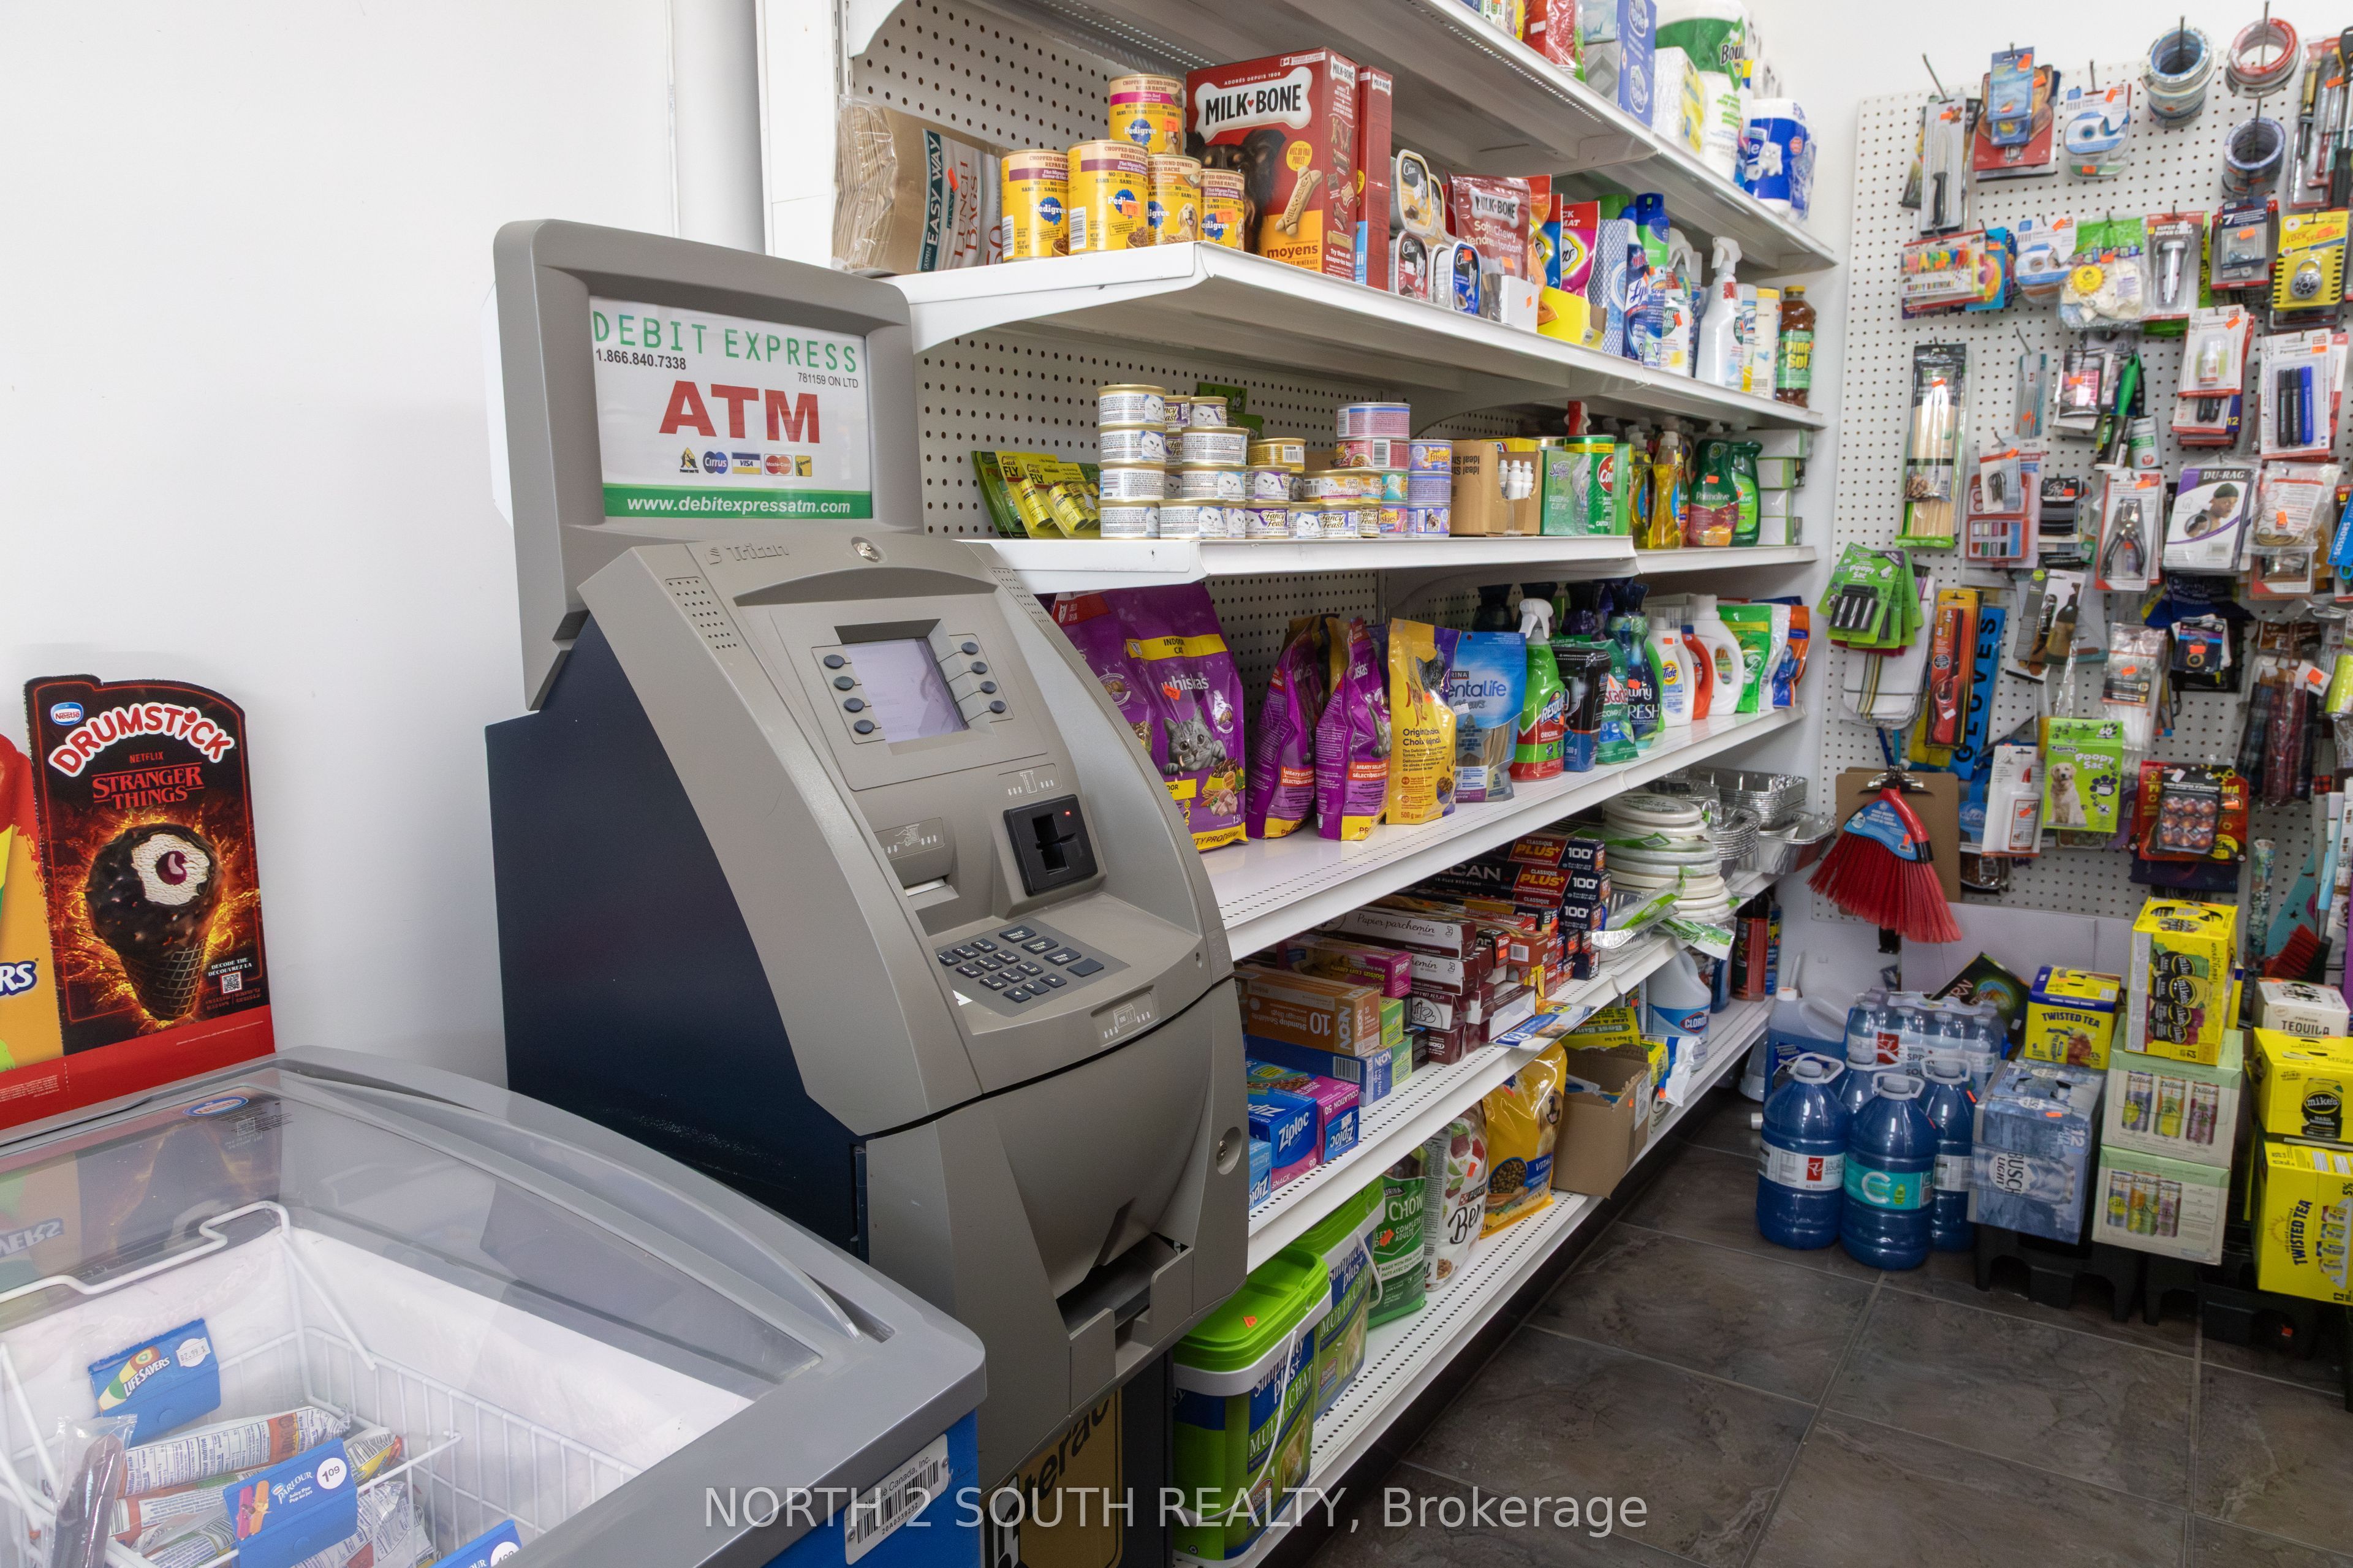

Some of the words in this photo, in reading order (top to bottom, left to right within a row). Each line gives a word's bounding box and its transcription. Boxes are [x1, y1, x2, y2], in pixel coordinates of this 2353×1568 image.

[1205, 93, 1248, 126] MILK
[1256, 85, 1302, 113] BONE
[1124, 127, 1157, 135] Pedigree
[929, 135, 942, 180] WAY
[926, 187, 942, 245] EASY
[954, 161, 968, 258] LUNCH
[966, 175, 978, 251] BAGS
[1033, 204, 1067, 214] Pedigree
[1267, 244, 1318, 258] moyens
[593, 310, 707, 354] DEBIT
[725, 328, 857, 373] EXPRESS
[596, 349, 686, 370] 1.866.840.7338
[797, 372, 825, 385] 781159
[828, 376, 841, 387] ON
[843, 377, 858, 388] LTD
[659, 379, 820, 444] ATM
[704, 456, 727, 469] Cirrus
[1463, 455, 1480, 464] Ideal
[1003, 466, 1019, 477] FLY
[1463, 466, 1480, 475] Ideal
[2203, 470, 2245, 480] DU-RAG
[1030, 474, 1044, 484] FLY
[1696, 491, 1730, 501] Palmolive
[627, 496, 851, 516] www.debitexpressatm.com
[1264, 511, 1286, 521] Fancy
[1321, 513, 1344, 522] Fancy
[1322, 521, 1344, 529] Feast
[726, 543, 789, 561] Triton
[1663, 666, 1677, 678] Tide
[1629, 705, 1660, 719] RESH
[51, 703, 233, 776] DRUMSTICK
[129, 751, 164, 763] NETFLIX
[2075, 753, 2115, 762] Poopy
[2083, 760, 2104, 769] Sac
[92, 766, 204, 798] STRANGER
[110, 787, 188, 810] THINGS
[1523, 896, 1550, 905] CLASSIQUE
[1385, 920, 1436, 934] parchemin
[211, 960, 235, 970] DECODE
[1310, 1012, 1331, 1036] 10
[2041, 1012, 2082, 1022] TWISTED
[2083, 1017, 2101, 1028] TEA
[2281, 1020, 2330, 1036] TEQUILA
[1333, 1089, 1358, 1108] COLLATION
[1325, 1105, 1333, 1115] 50
[1279, 1112, 1309, 1153] Ziploc
[1330, 1124, 1355, 1148] Ziploc
[1996, 1156, 2006, 1185] LIGHT
[2006, 1151, 2025, 1197] BUSCH
[1271, 1173, 1291, 1188] SNACK
[1469, 1186, 1485, 1198] PURI
[1389, 1191, 1423, 1221] CHOW
[2296, 1199, 2313, 1219] TEA
[1396, 1216, 1422, 1233] COMPLETE
[2290, 1220, 2309, 1266] TWISTED
[889, 1466, 918, 1491] Canada,
[919, 1456, 931, 1468] Inc.
[276, 1471, 313, 1504] PARLOUR
[882, 1502, 919, 1536] 20A0339232
